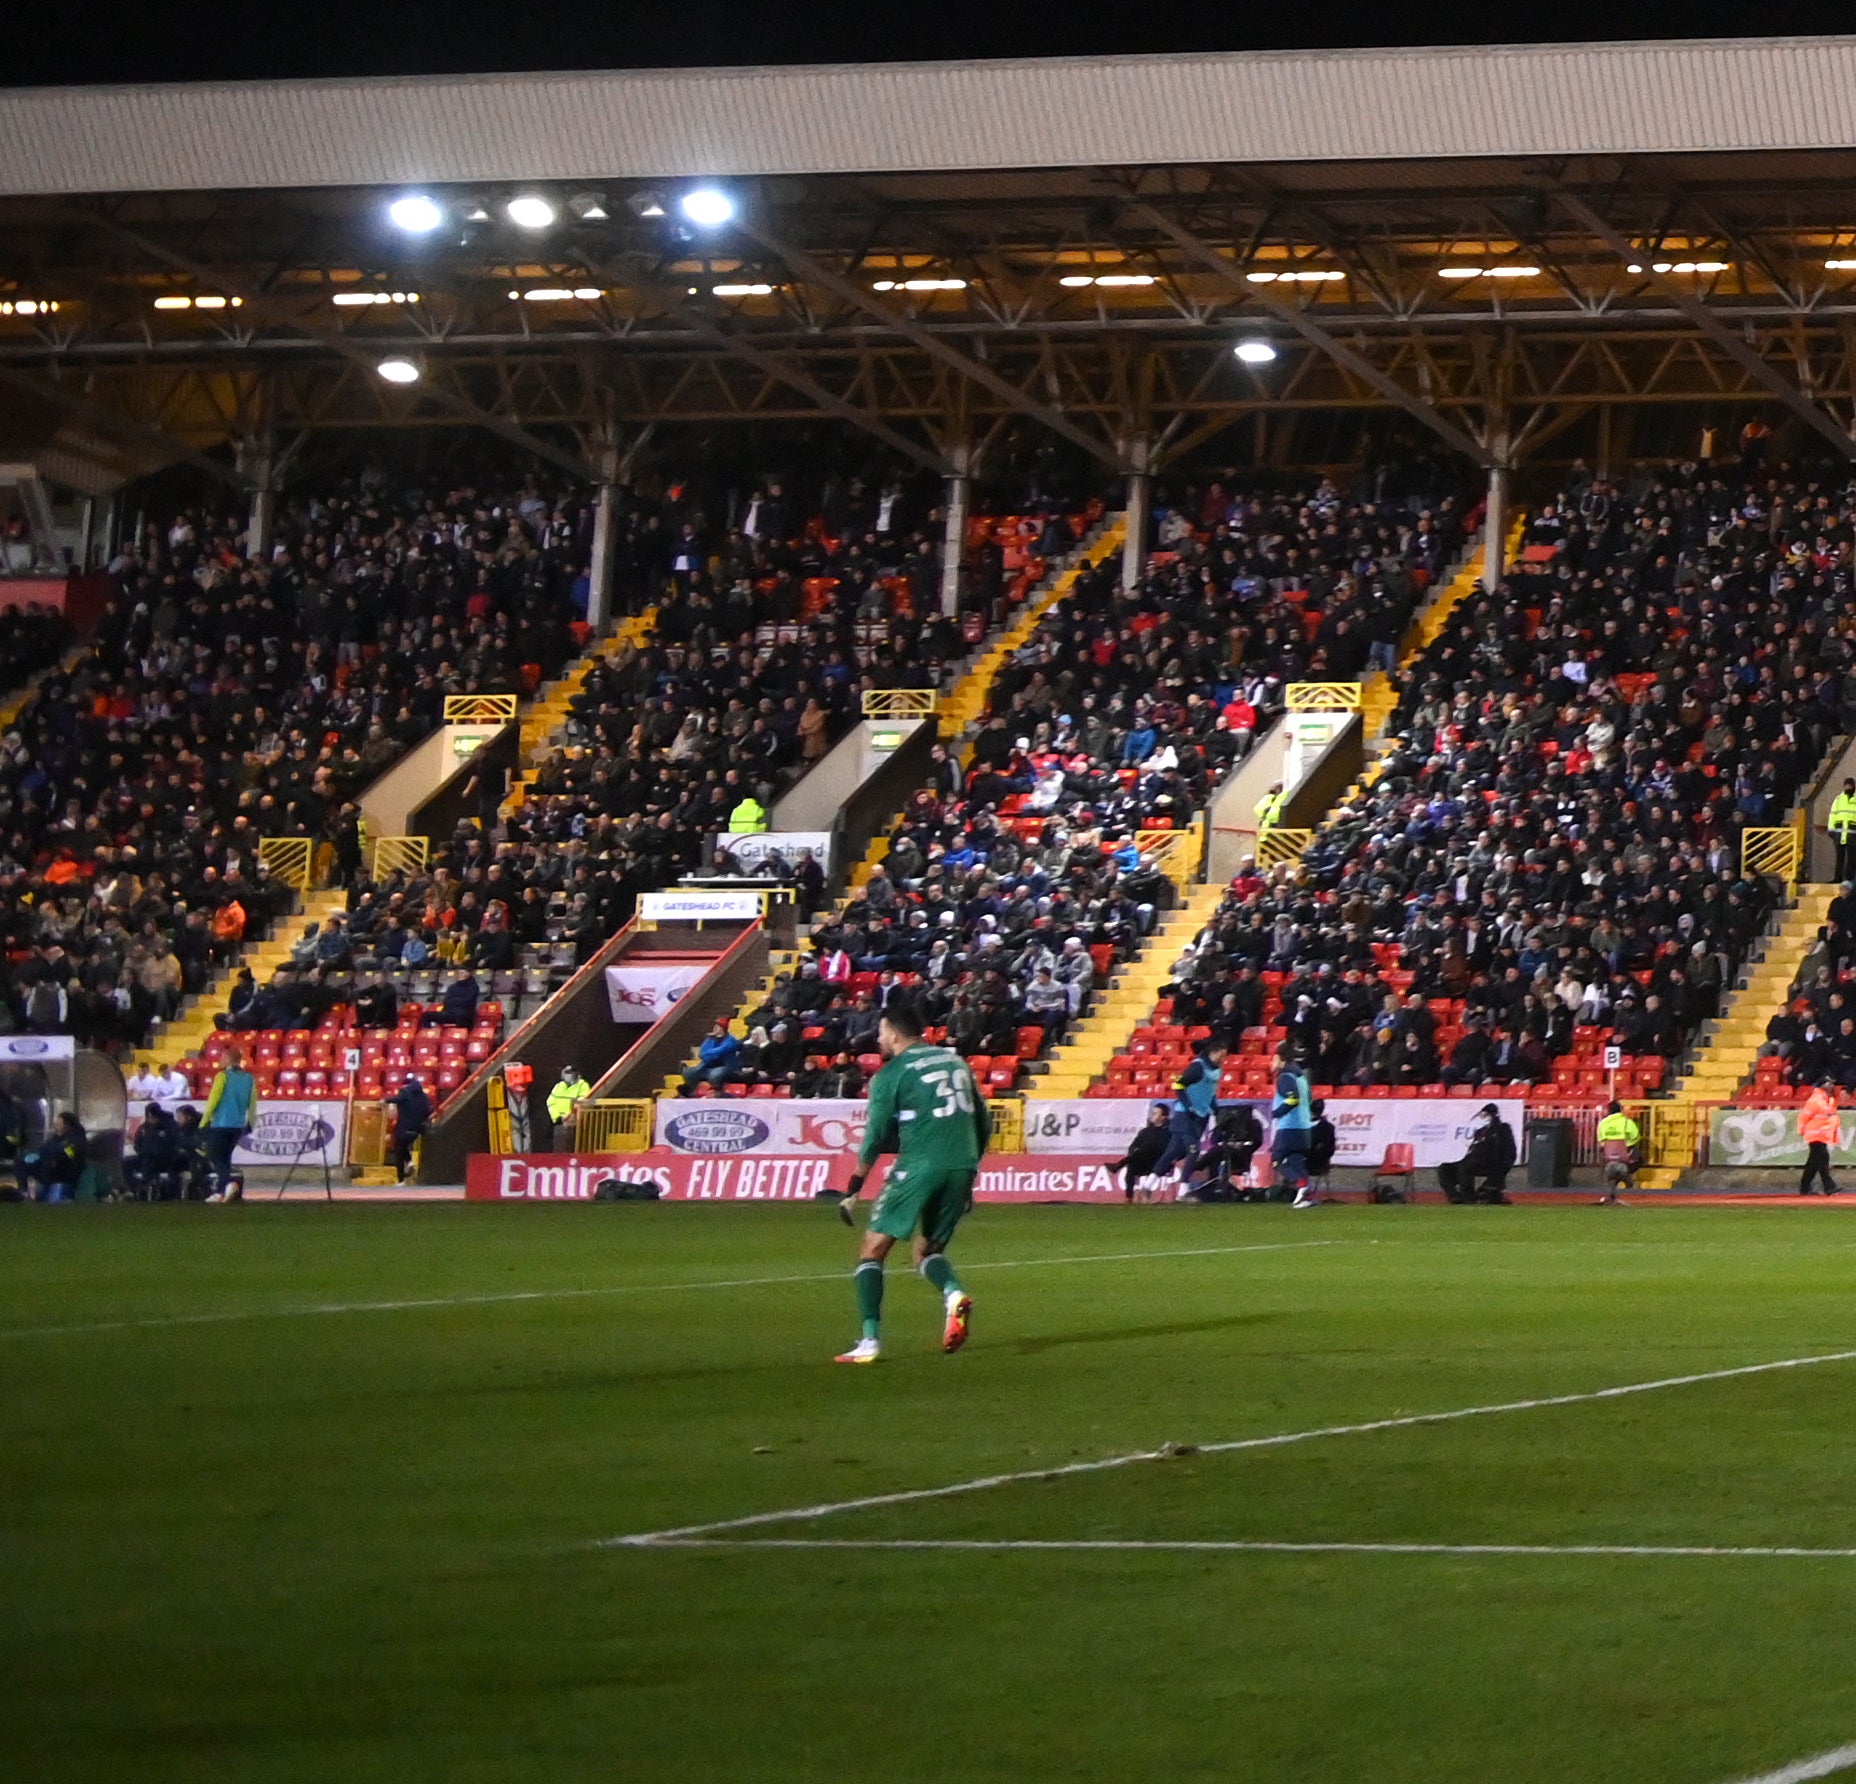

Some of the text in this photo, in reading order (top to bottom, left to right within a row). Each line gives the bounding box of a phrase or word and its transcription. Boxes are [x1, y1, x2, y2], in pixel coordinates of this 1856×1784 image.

[663, 901, 737, 911] GATESHEAD FC
[348, 1053, 357, 1065] 4
[1607, 1051, 1618, 1064] B
[920, 1068, 976, 1118] 30
[676, 1112, 758, 1128] GATESHEAD
[1027, 1113, 1081, 1137] J&P
[683, 1139, 746, 1153] CENTRAL
[686, 1160, 730, 1198] FLY
[735, 1159, 830, 1198] BETTER
[972, 1166, 1074, 1192] mirates
[1077, 1165, 1114, 1192] FA
